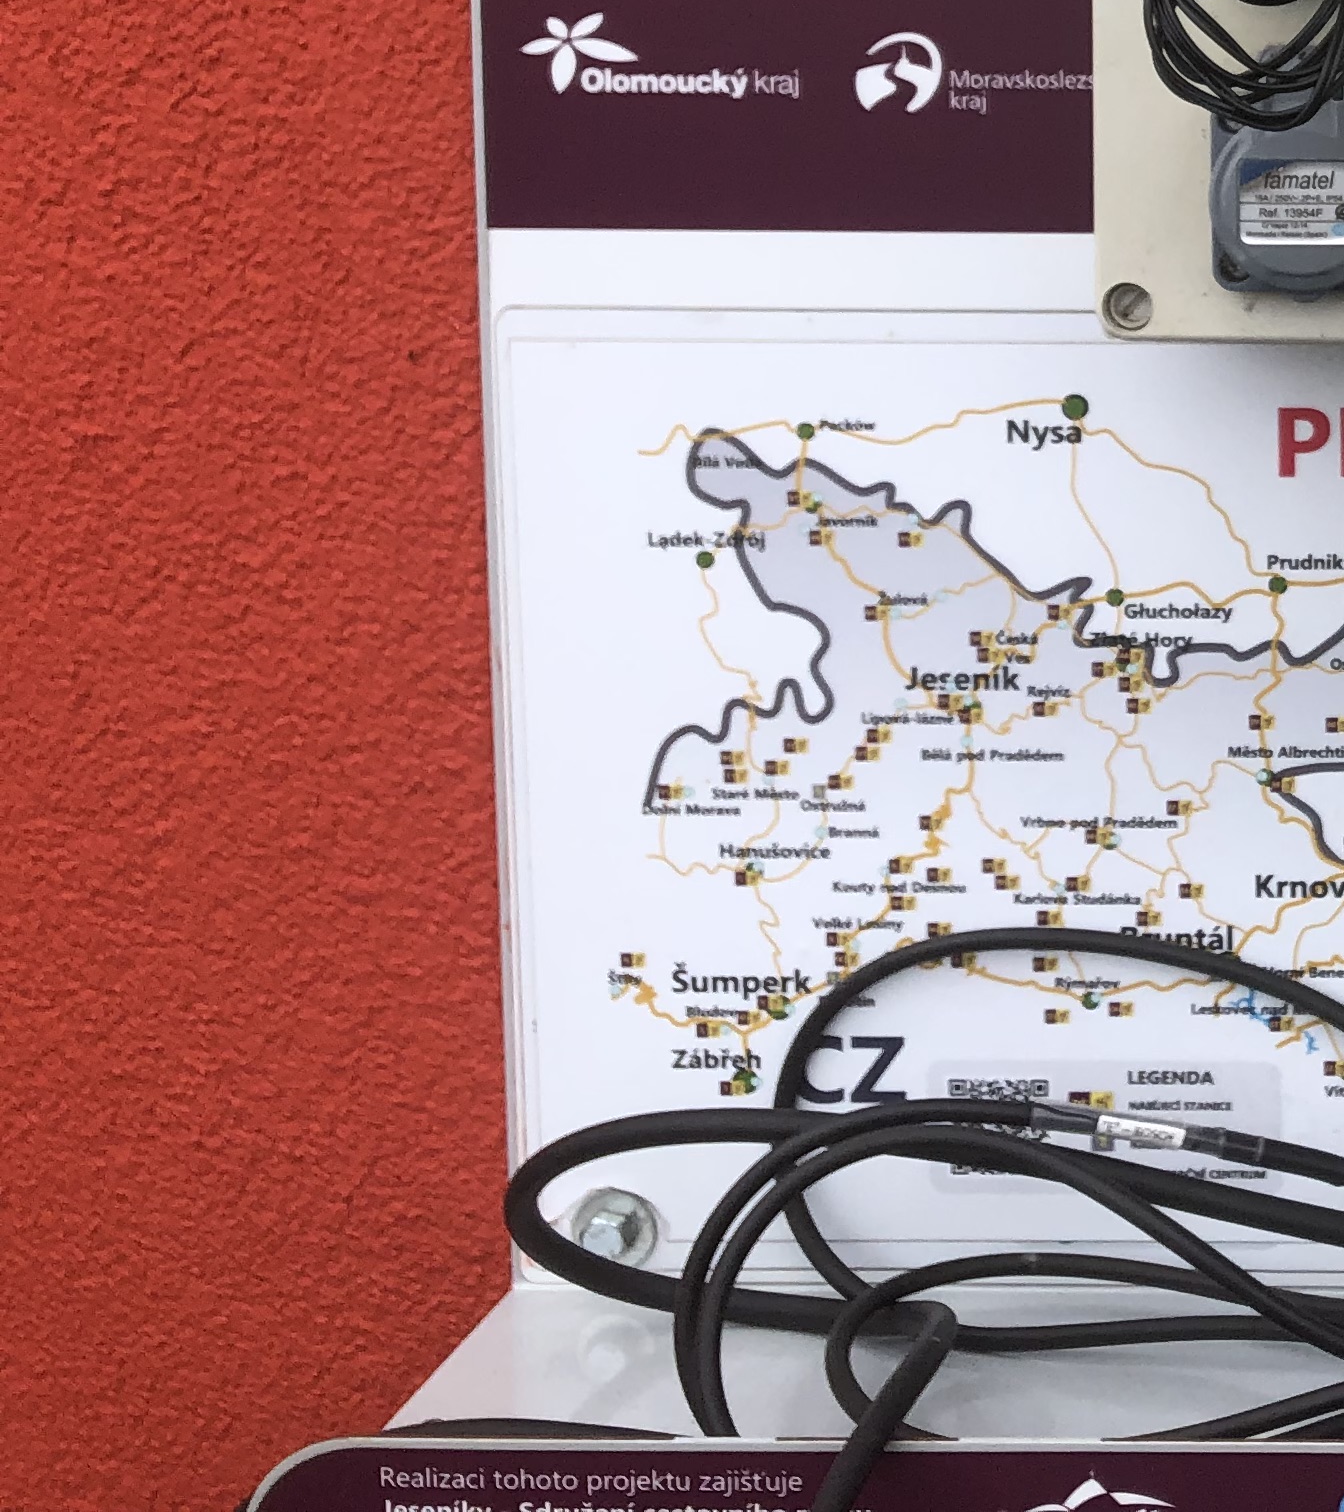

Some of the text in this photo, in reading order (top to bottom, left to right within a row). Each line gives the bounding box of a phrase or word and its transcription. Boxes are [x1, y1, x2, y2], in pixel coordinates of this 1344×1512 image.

[580, 66, 800, 99] Olomoucký kraj
[949, 90, 987, 115] kraj
[1007, 420, 1082, 451] Nysa
[1266, 554, 1344, 571] Prudnik
[672, 962, 811, 999] Šumperk
[672, 1049, 761, 1070] Zábřeh
[380, 1466, 803, 1497] Realizaci tohoto projektu zajišťuje
